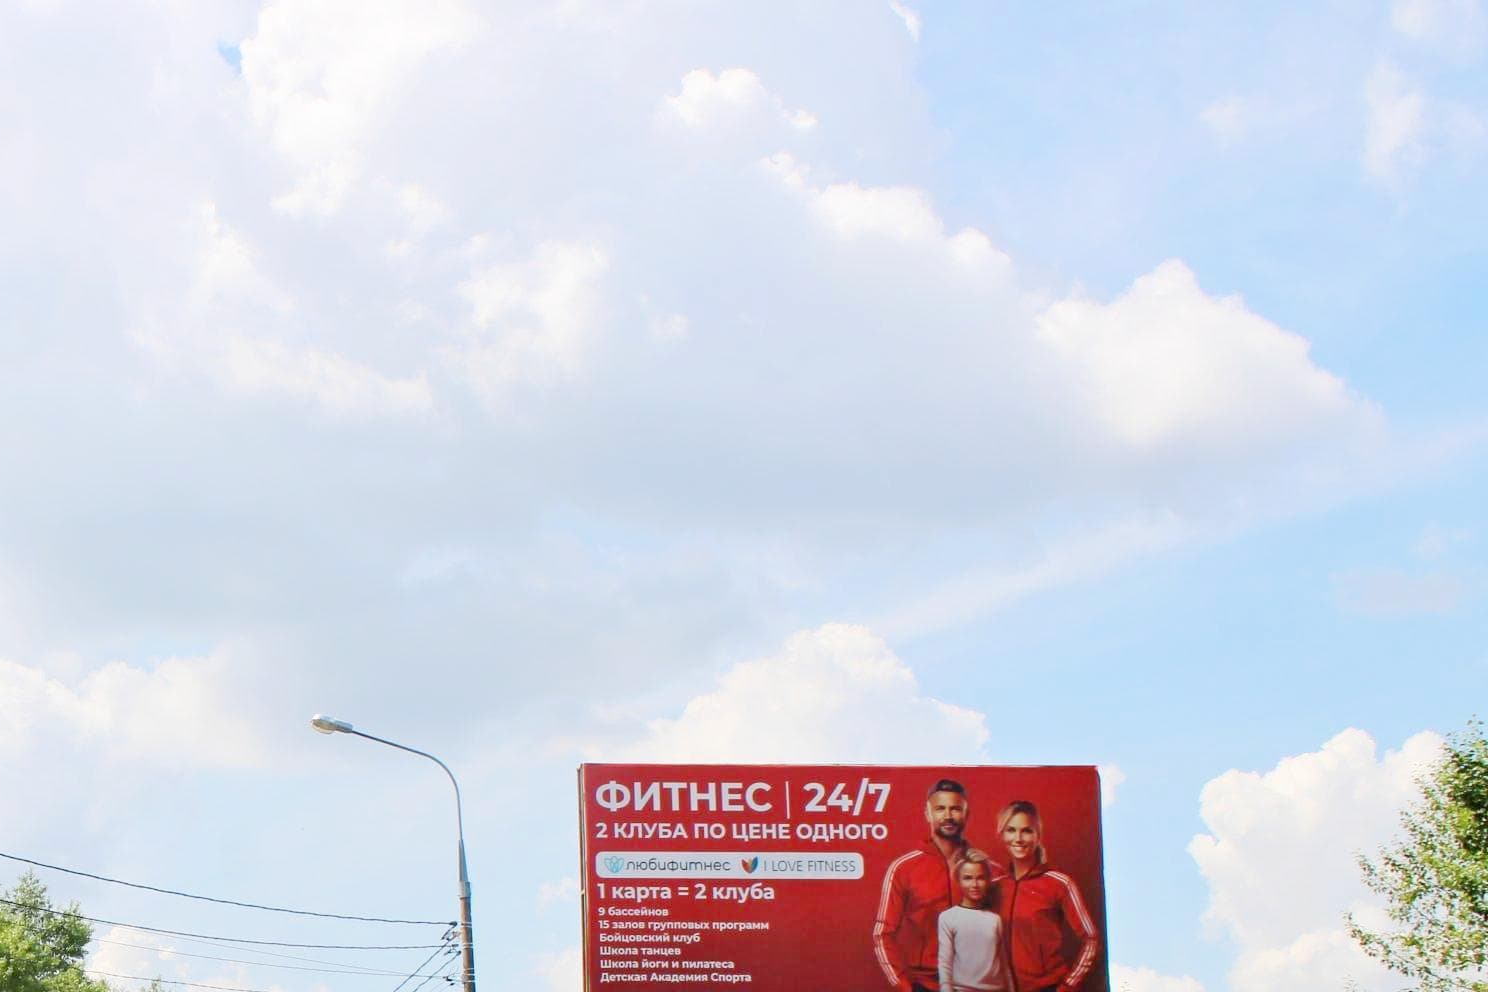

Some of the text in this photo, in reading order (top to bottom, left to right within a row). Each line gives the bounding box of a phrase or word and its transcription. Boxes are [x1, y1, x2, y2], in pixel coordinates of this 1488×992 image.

[595, 777, 891, 816] ФИТНЕС 24/7
[595, 823, 889, 843] 2 КЛУБА ПО ЦЕНЕ ОДНОГО
[626, 857, 732, 873] любифитнес
[771, 859, 804, 873] LOVE
[808, 860, 856, 873] FITNESS
[597, 883, 605, 900] 1
[612, 885, 672, 903] карта
[694, 883, 707, 900] 2
[713, 882, 775, 904] клуба
[598, 906, 669, 917] 9 бассейнов
[598, 920, 770, 932] 15 залов групповых программ
[599, 932, 701, 944] Бойцовский клуб
[600, 946, 681, 957] Школа танцев
[600, 959, 735, 970] Школа йоги и пилатеса
[600, 973, 752, 984] Детская Академия Спорта
